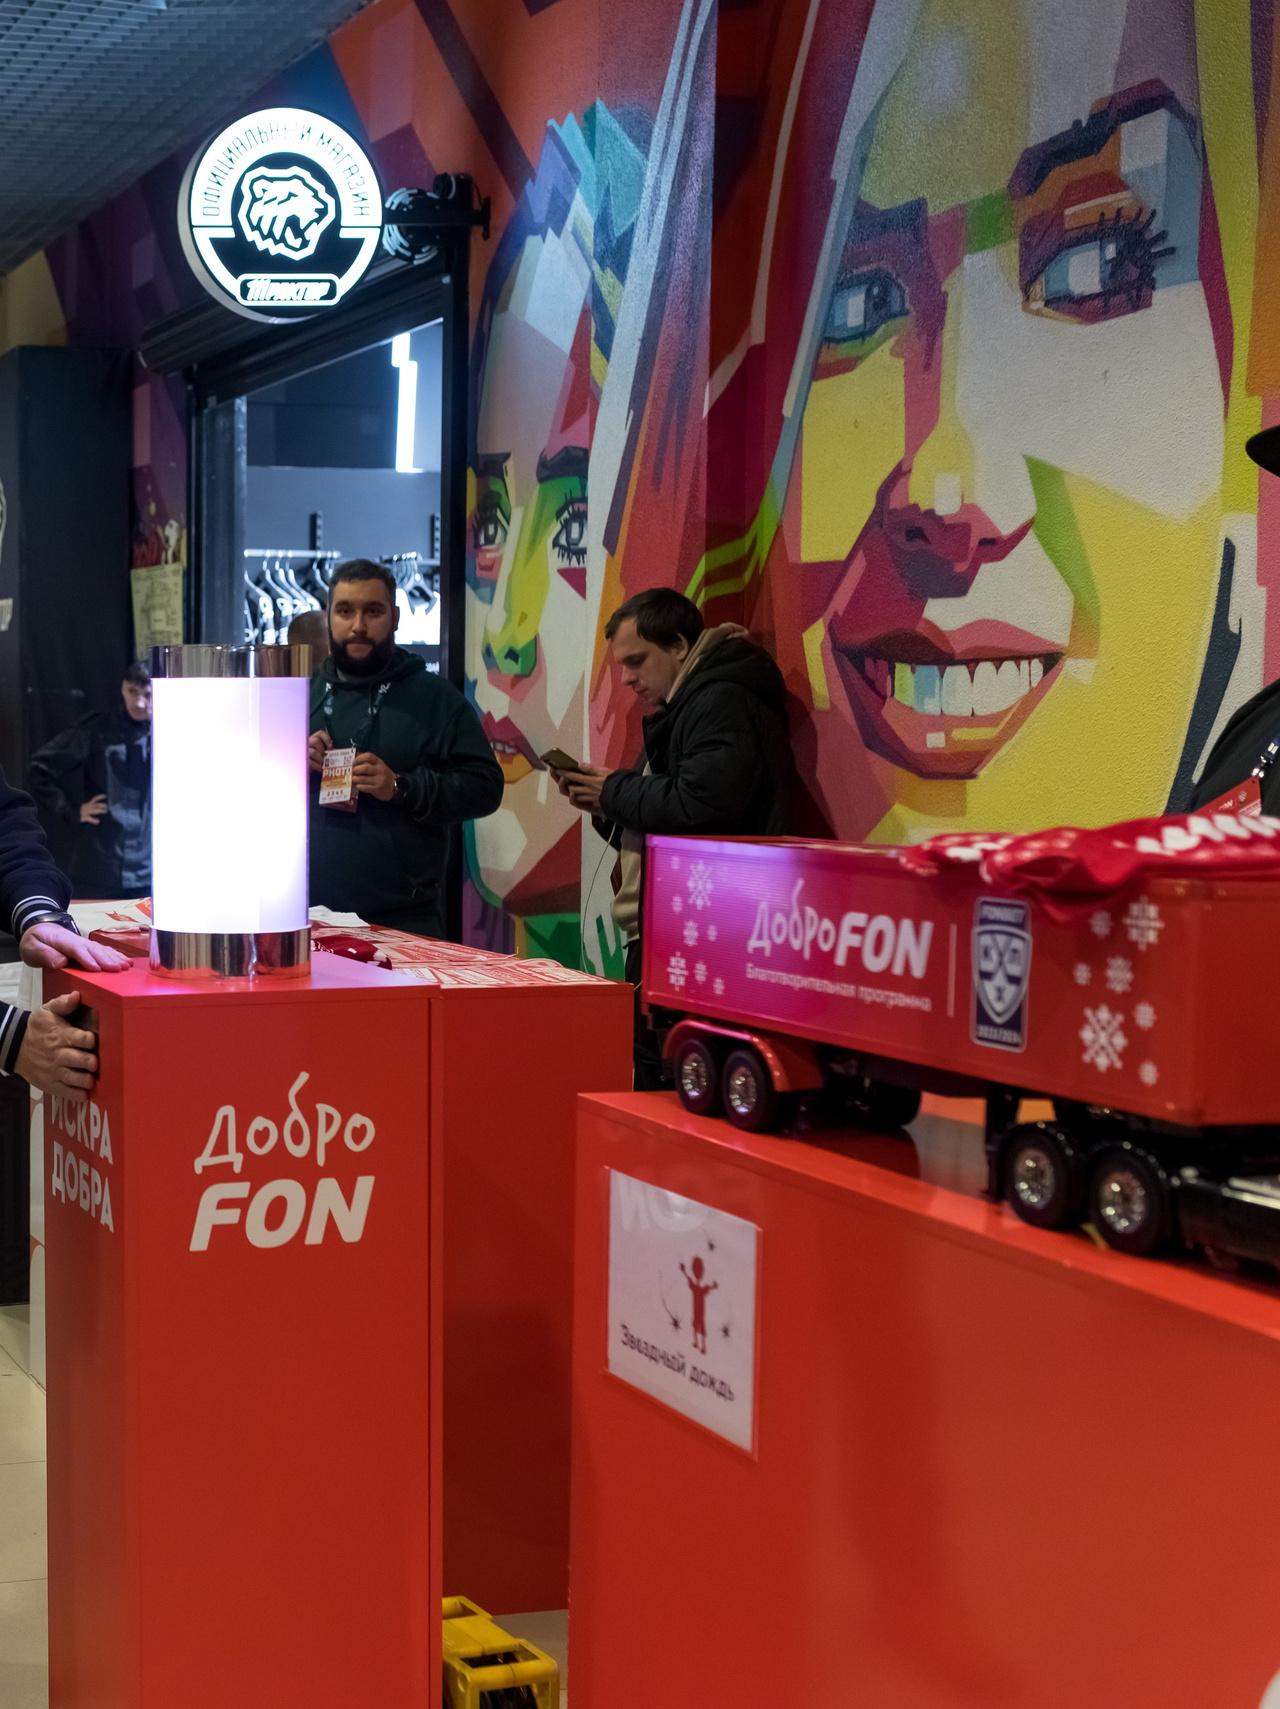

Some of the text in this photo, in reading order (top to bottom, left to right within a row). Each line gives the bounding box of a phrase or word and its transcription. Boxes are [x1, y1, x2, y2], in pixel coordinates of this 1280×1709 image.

[202, 119, 370, 217] ОФИЦИАЛЬНЫЙ МАГАЗИН
[323, 766, 351, 778] PHOTO
[858, 985, 932, 1012] программа
[51, 1095, 114, 1165] ИСКРА
[194, 1071, 375, 1175] Добро
[52, 1140, 114, 1233] ДОБРА
[189, 1176, 375, 1252] FON
[689, 1365, 735, 1402] дождь
